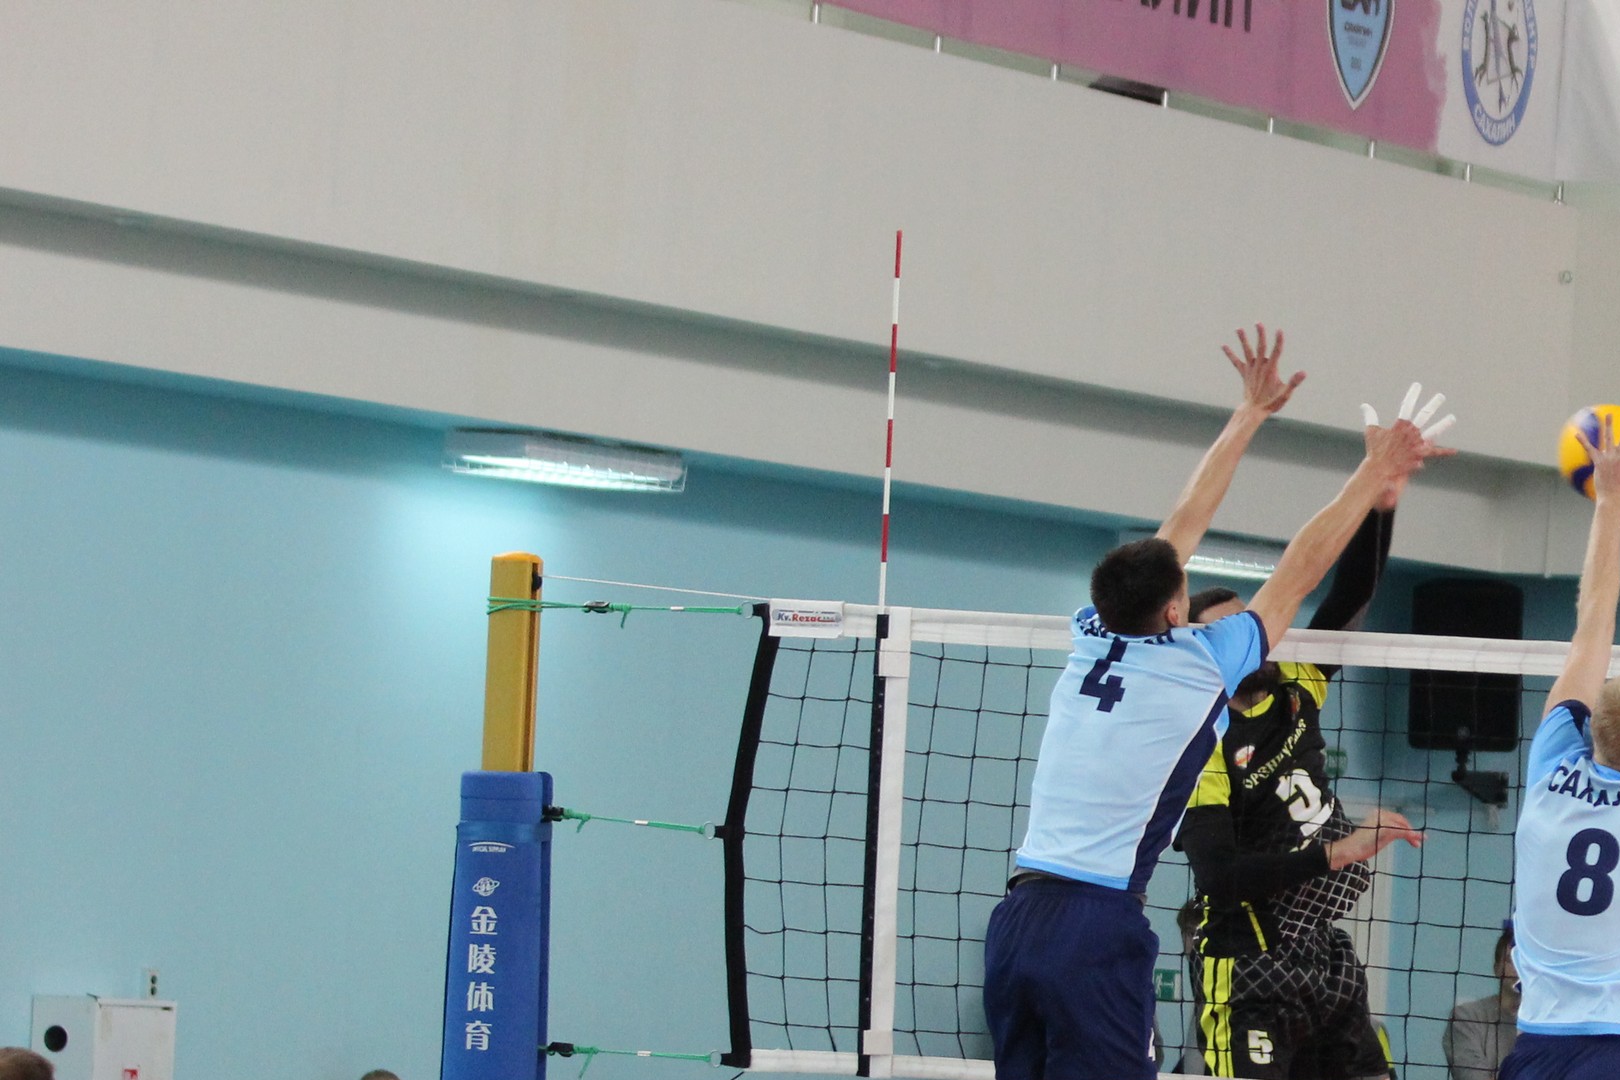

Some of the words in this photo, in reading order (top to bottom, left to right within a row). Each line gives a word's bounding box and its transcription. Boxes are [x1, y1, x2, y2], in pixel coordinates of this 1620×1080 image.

[1079, 636, 1126, 713] 4
[1556, 827, 1620, 917] 8
[465, 906, 498, 1051] 金陵体育
[1248, 1029, 1274, 1064] 5
